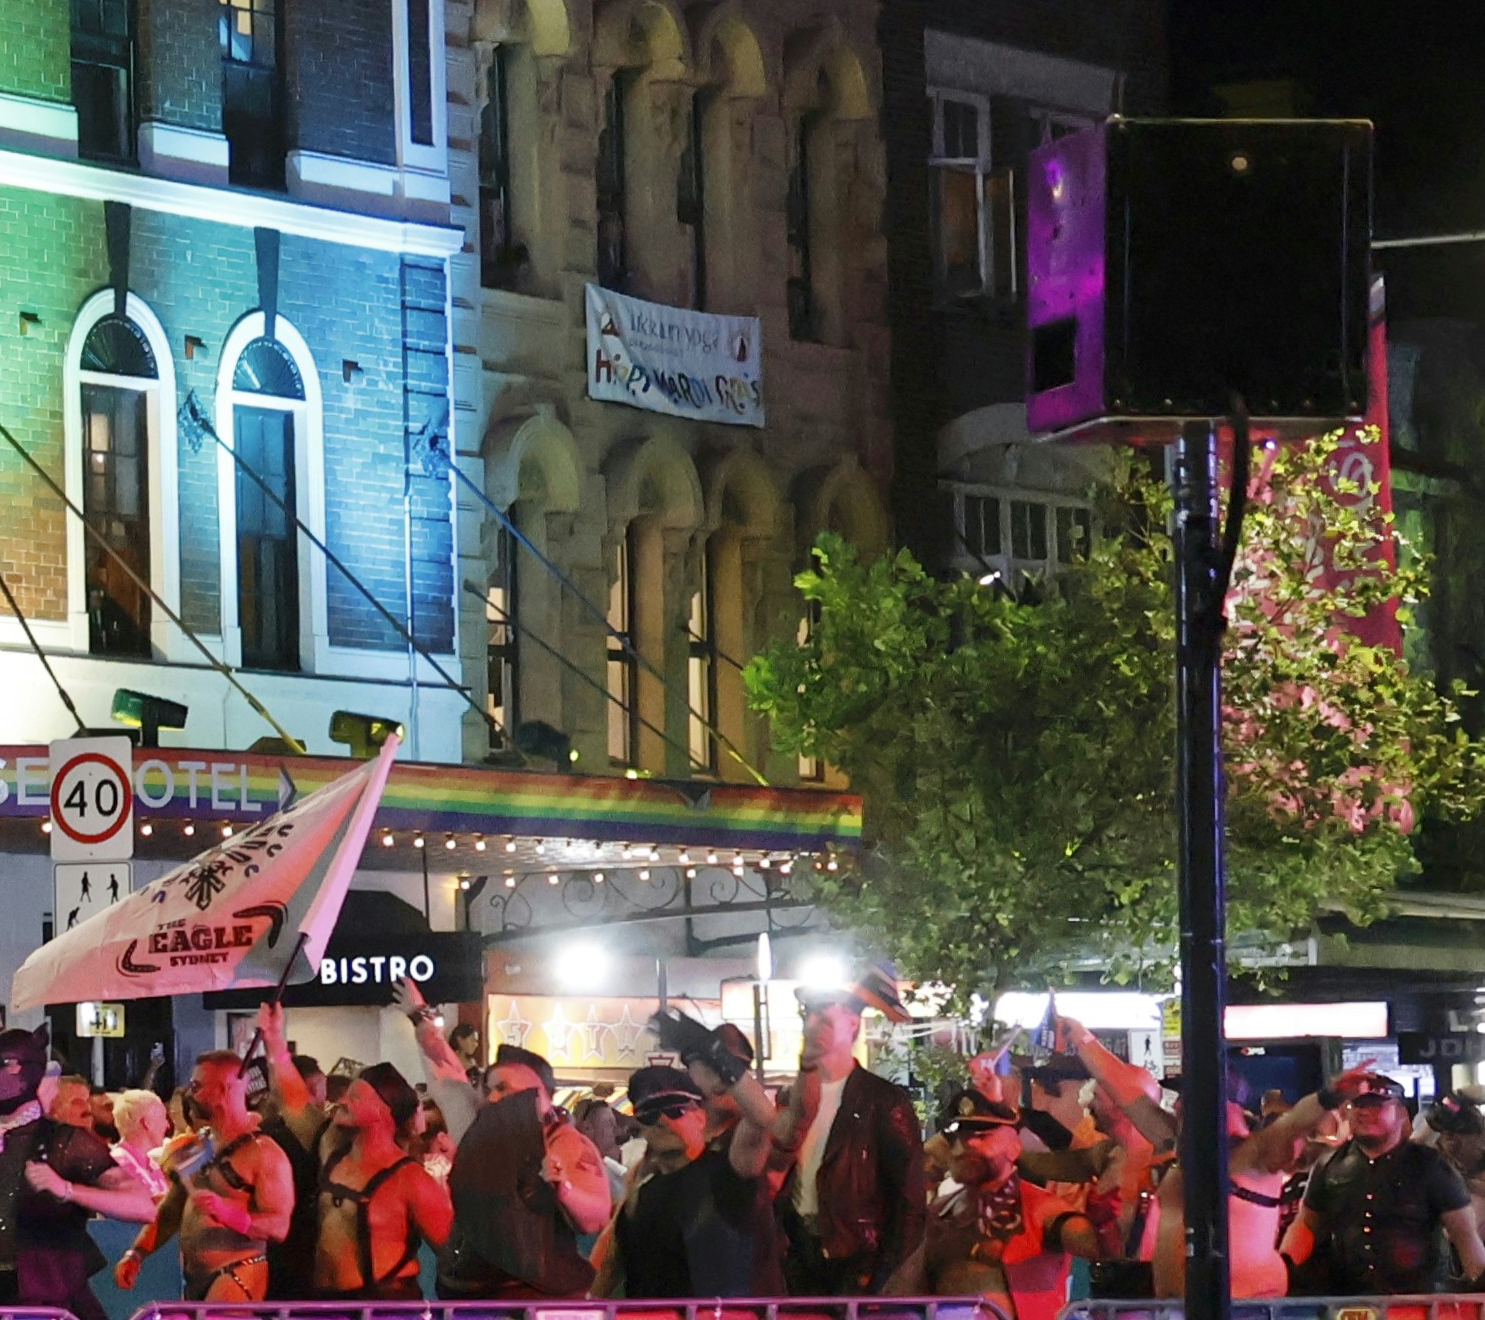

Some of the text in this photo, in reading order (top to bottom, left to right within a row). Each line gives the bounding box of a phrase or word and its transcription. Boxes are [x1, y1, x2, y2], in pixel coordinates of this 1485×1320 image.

[62, 780, 119, 819] 40
[132, 757, 264, 813] OTEL
[148, 925, 253, 955] EAGLE
[169, 951, 230, 967] SYDNEY
[320, 955, 435, 984] BISTRO
